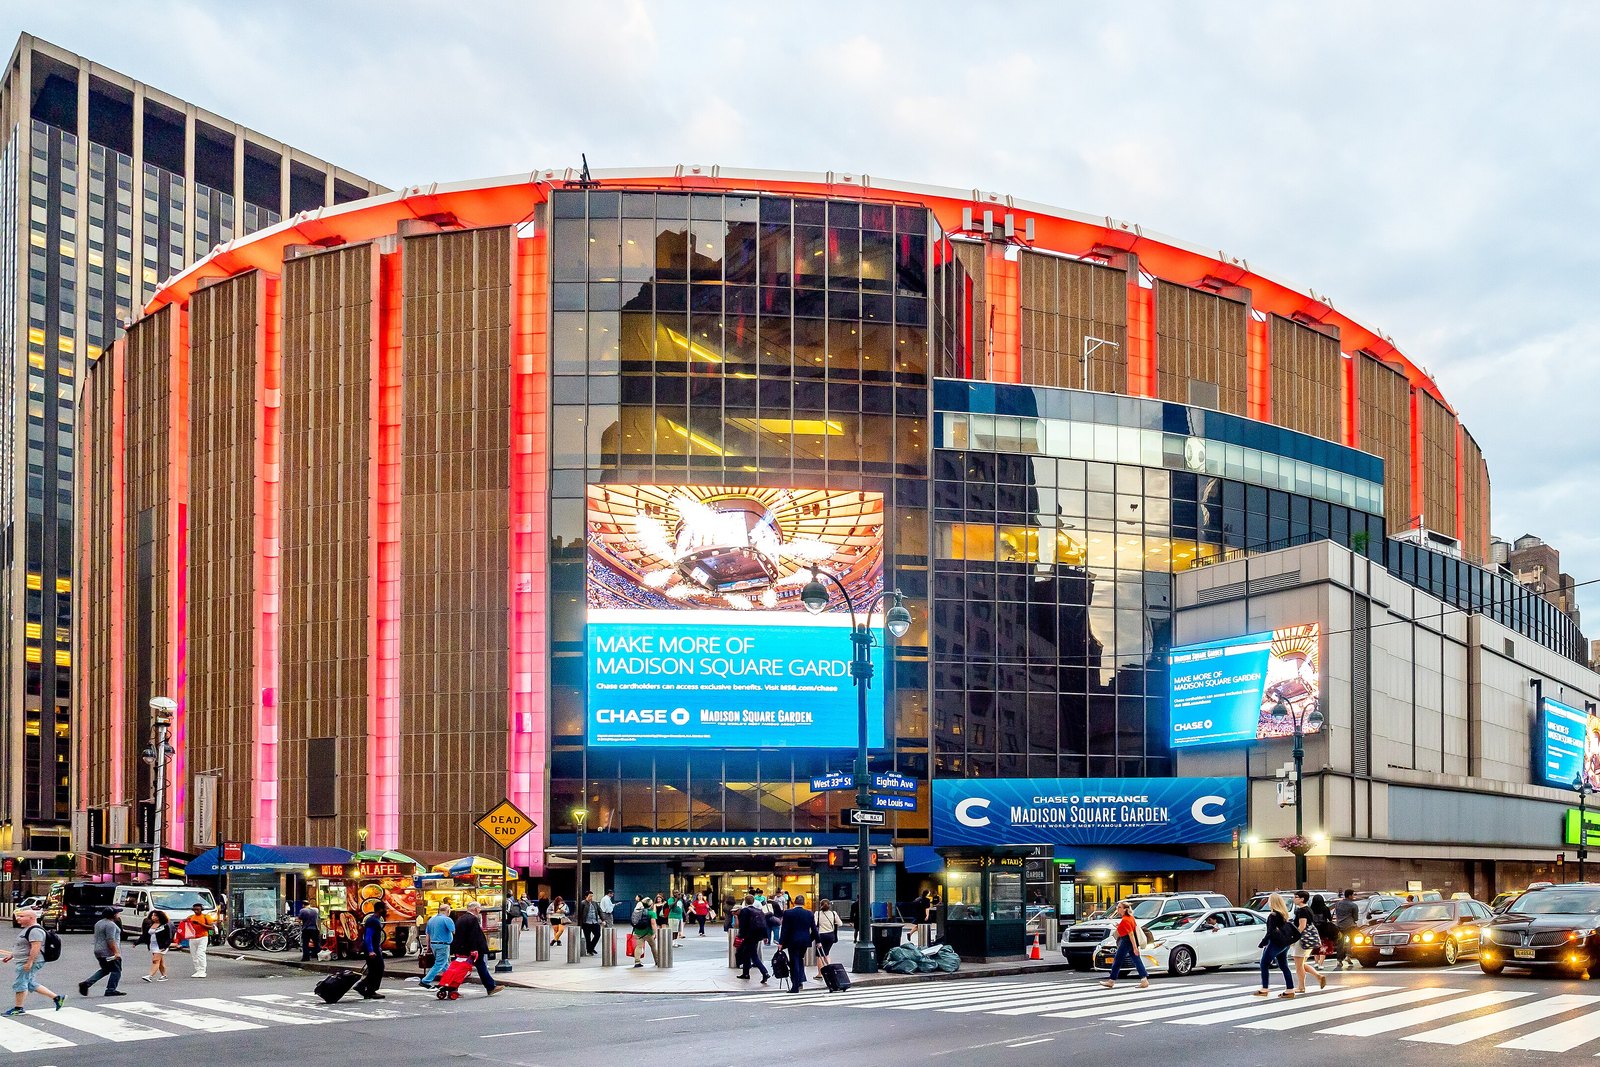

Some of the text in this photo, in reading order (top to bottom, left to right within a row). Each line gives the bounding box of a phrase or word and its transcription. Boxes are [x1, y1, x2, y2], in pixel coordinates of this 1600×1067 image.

[597, 636, 755, 654] MAKE MORE OF
[597, 657, 856, 679] MADISON SQUARE GARDE
[1174, 670, 1223, 685] MAKE MORE OF
[1174, 672, 1261, 691] MADISON SQUARE GARDEN
[596, 682, 618, 690] Chase
[619, 682, 661, 690] cardholders
[700, 683, 731, 691] exclusive
[733, 683, 762, 691] benefits.
[596, 709, 667, 724] CHASE
[700, 708, 740, 722] MADISON
[742, 709, 776, 723] SQUARE
[1174, 721, 1203, 731] CHASE
[814, 777, 852, 789] West 33rd St
[876, 776, 899, 788] Eighth
[900, 779, 914, 789] Ave
[876, 797, 887, 806] Joe
[888, 798, 903, 807] Louis
[1033, 795, 1149, 804] CHASE ENTRANCE
[955, 797, 991, 827] C
[1011, 806, 1066, 823] MADISON
[1070, 805, 1117, 823] SQUARE
[1191, 795, 1227, 825] C
[490, 815, 521, 824] DEAD
[494, 826, 517, 835] END
[632, 837, 813, 846] PENNSYLVANIA STATION
[321, 865, 343, 876] HOT DOG
[358, 864, 401, 876] ALAFEL
